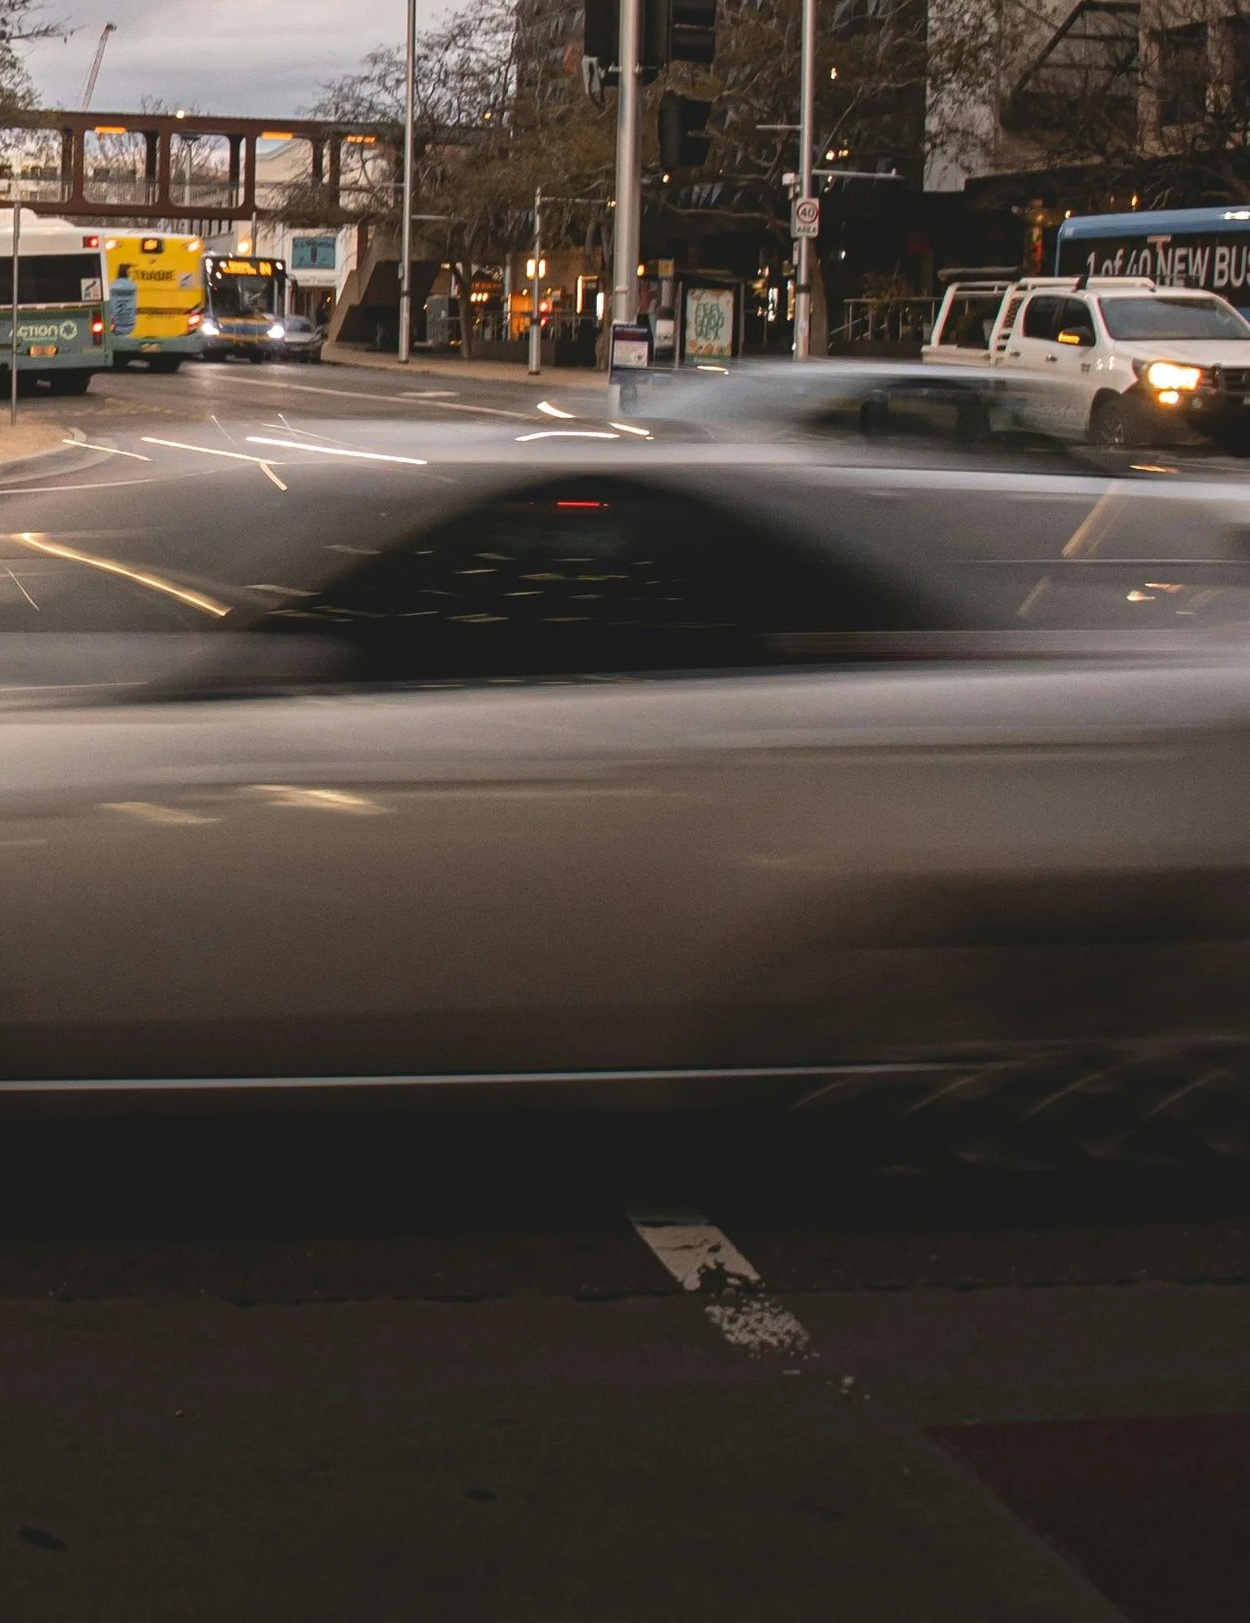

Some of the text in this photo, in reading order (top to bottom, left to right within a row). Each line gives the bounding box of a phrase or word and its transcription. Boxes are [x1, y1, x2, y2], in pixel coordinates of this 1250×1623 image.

[800, 208, 815, 218] 40
[1087, 251, 1096, 276] 1
[1101, 248, 1123, 276] of
[1156, 246, 1210, 287] NEW
[9, 325, 58, 338] CTION
